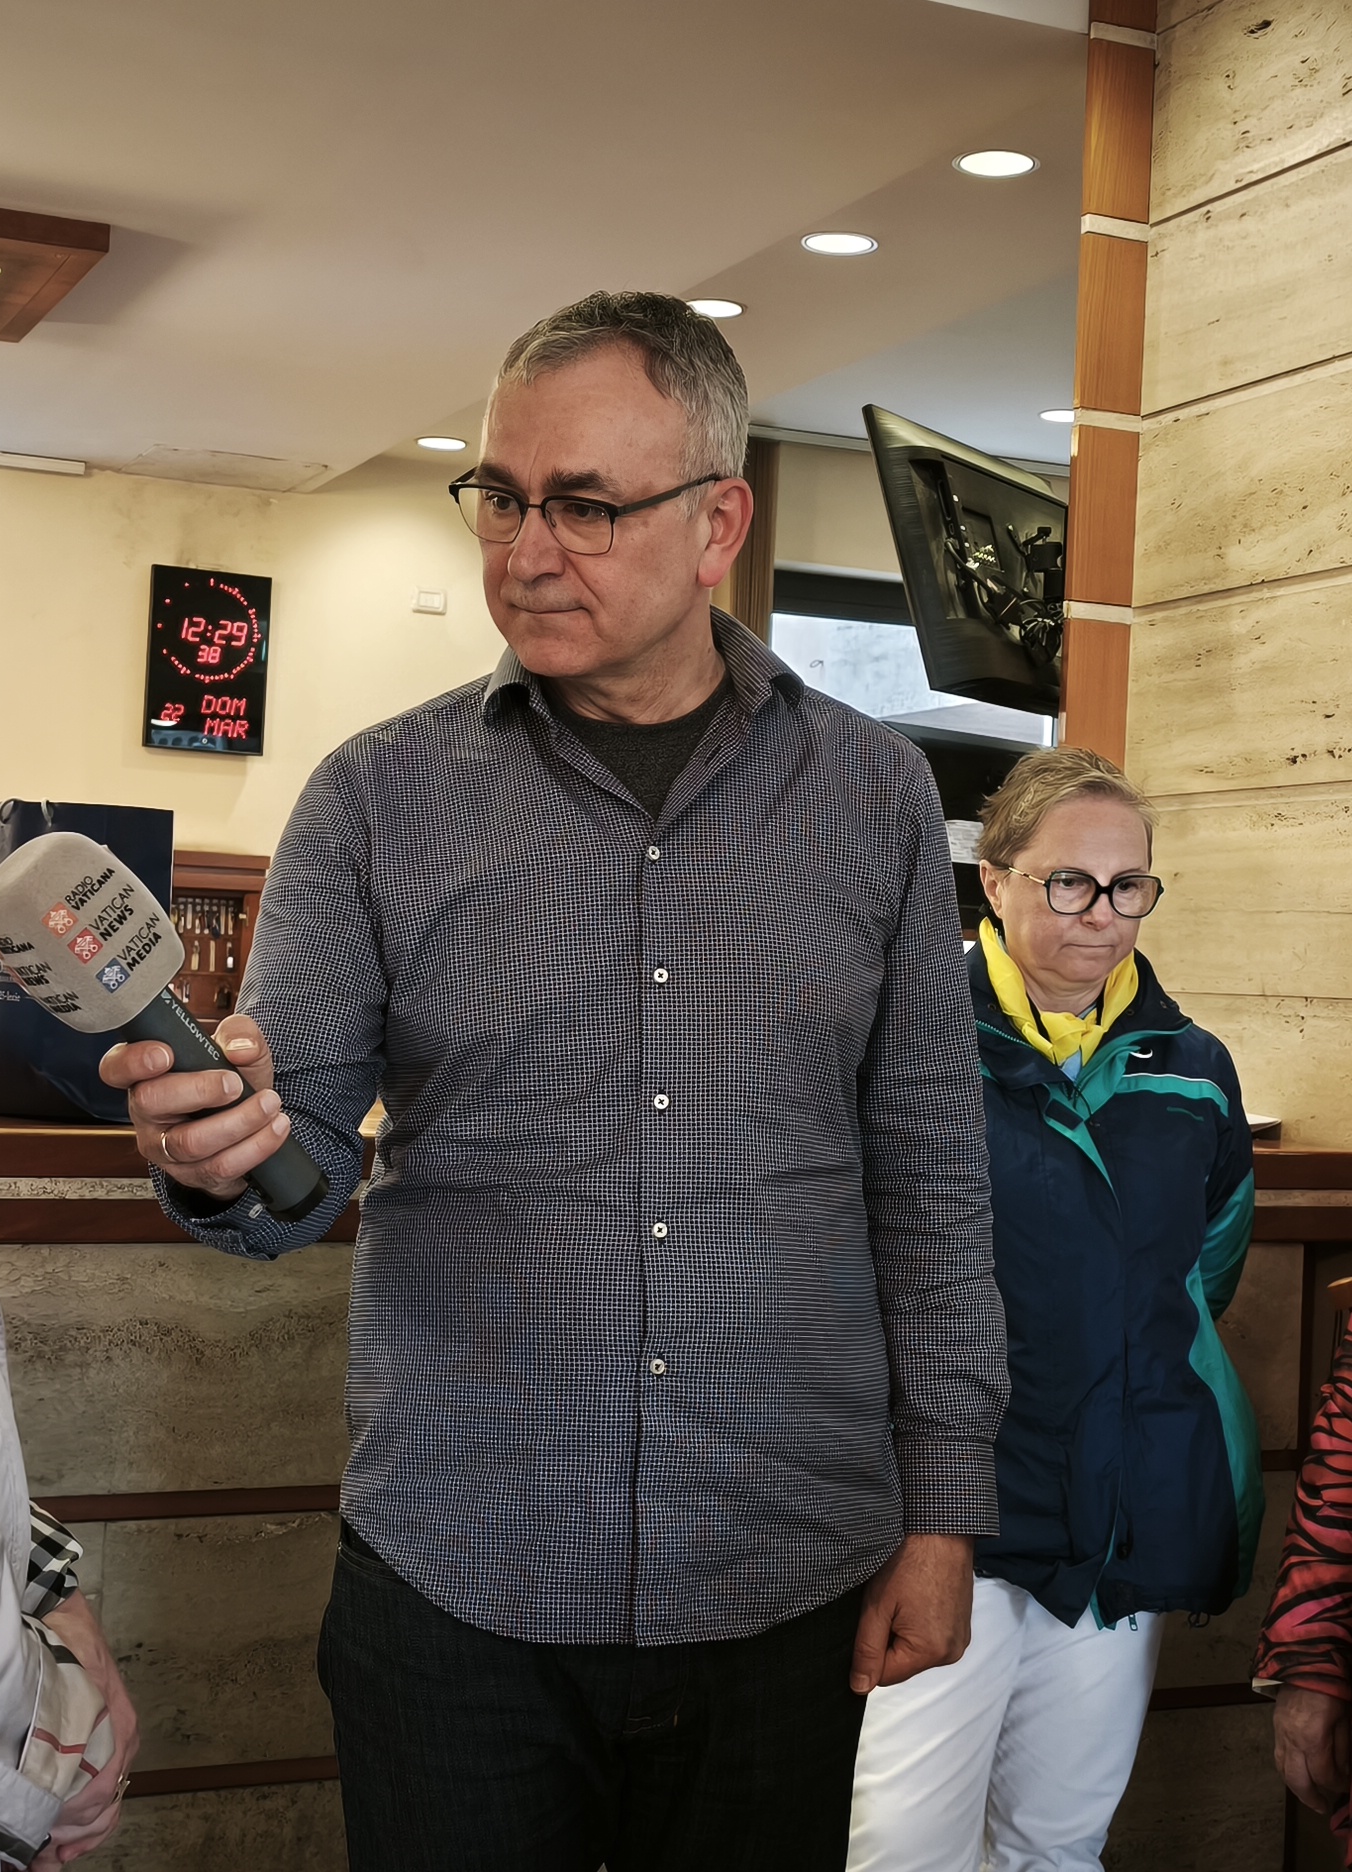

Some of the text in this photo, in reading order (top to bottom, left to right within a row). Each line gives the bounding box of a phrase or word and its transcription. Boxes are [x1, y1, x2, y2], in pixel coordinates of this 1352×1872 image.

[181, 617, 248, 646] 12:29
[197, 645, 221, 664] 38
[160, 703, 185, 721] 22
[201, 694, 246, 716] DOM
[204, 717, 249, 739] MAR
[64, 875, 94, 905] RADIO
[71, 867, 115, 911] VATICANA
[89, 883, 135, 931] VATICAN
[99, 904, 134, 941] NEWS
[117, 912, 160, 961] VATICAN
[126, 931, 162, 972] MEDIA
[171, 1000, 221, 1061] YELLOWTEC
